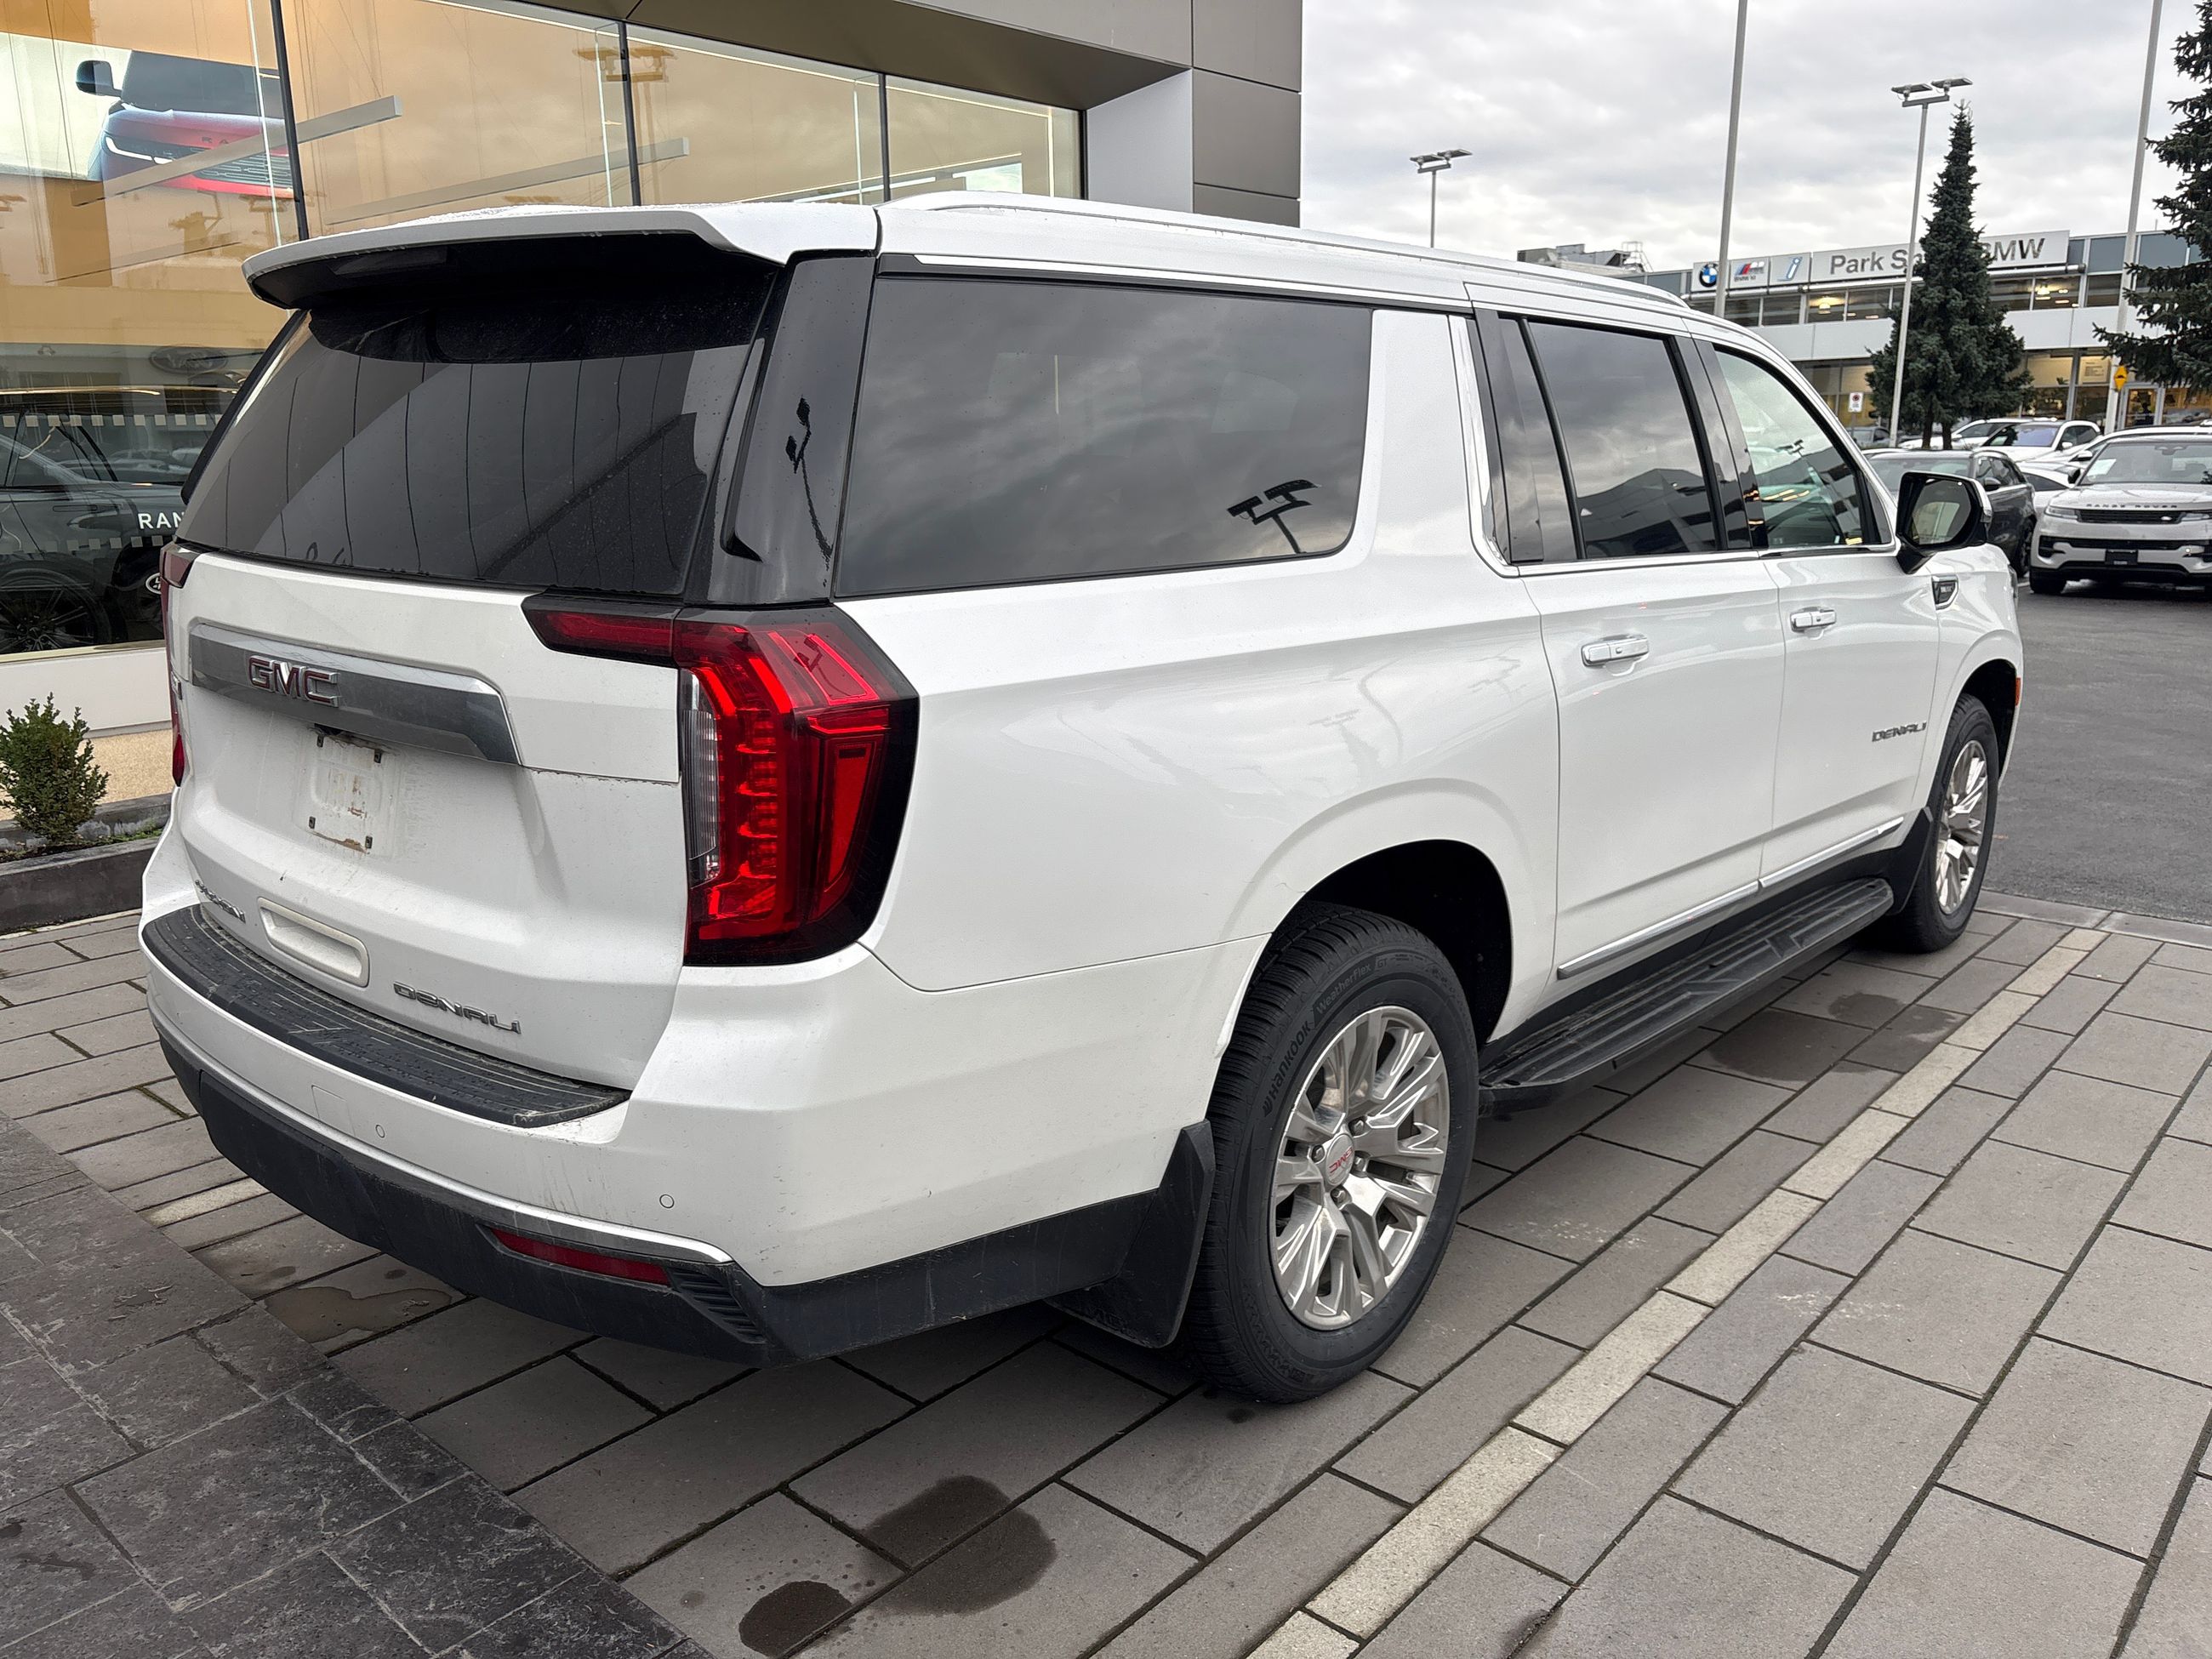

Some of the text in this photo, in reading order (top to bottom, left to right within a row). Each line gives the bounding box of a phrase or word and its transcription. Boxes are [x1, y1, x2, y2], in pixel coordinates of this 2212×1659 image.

[1830, 251, 1884, 275] Park
[248, 655, 339, 708] GMC
[1872, 721, 1927, 742] DENALI
[1317, 956, 1388, 1015] Weatherflex GT
[393, 981, 522, 1035] DENALI
[1329, 1145, 1353, 1174] GMC
